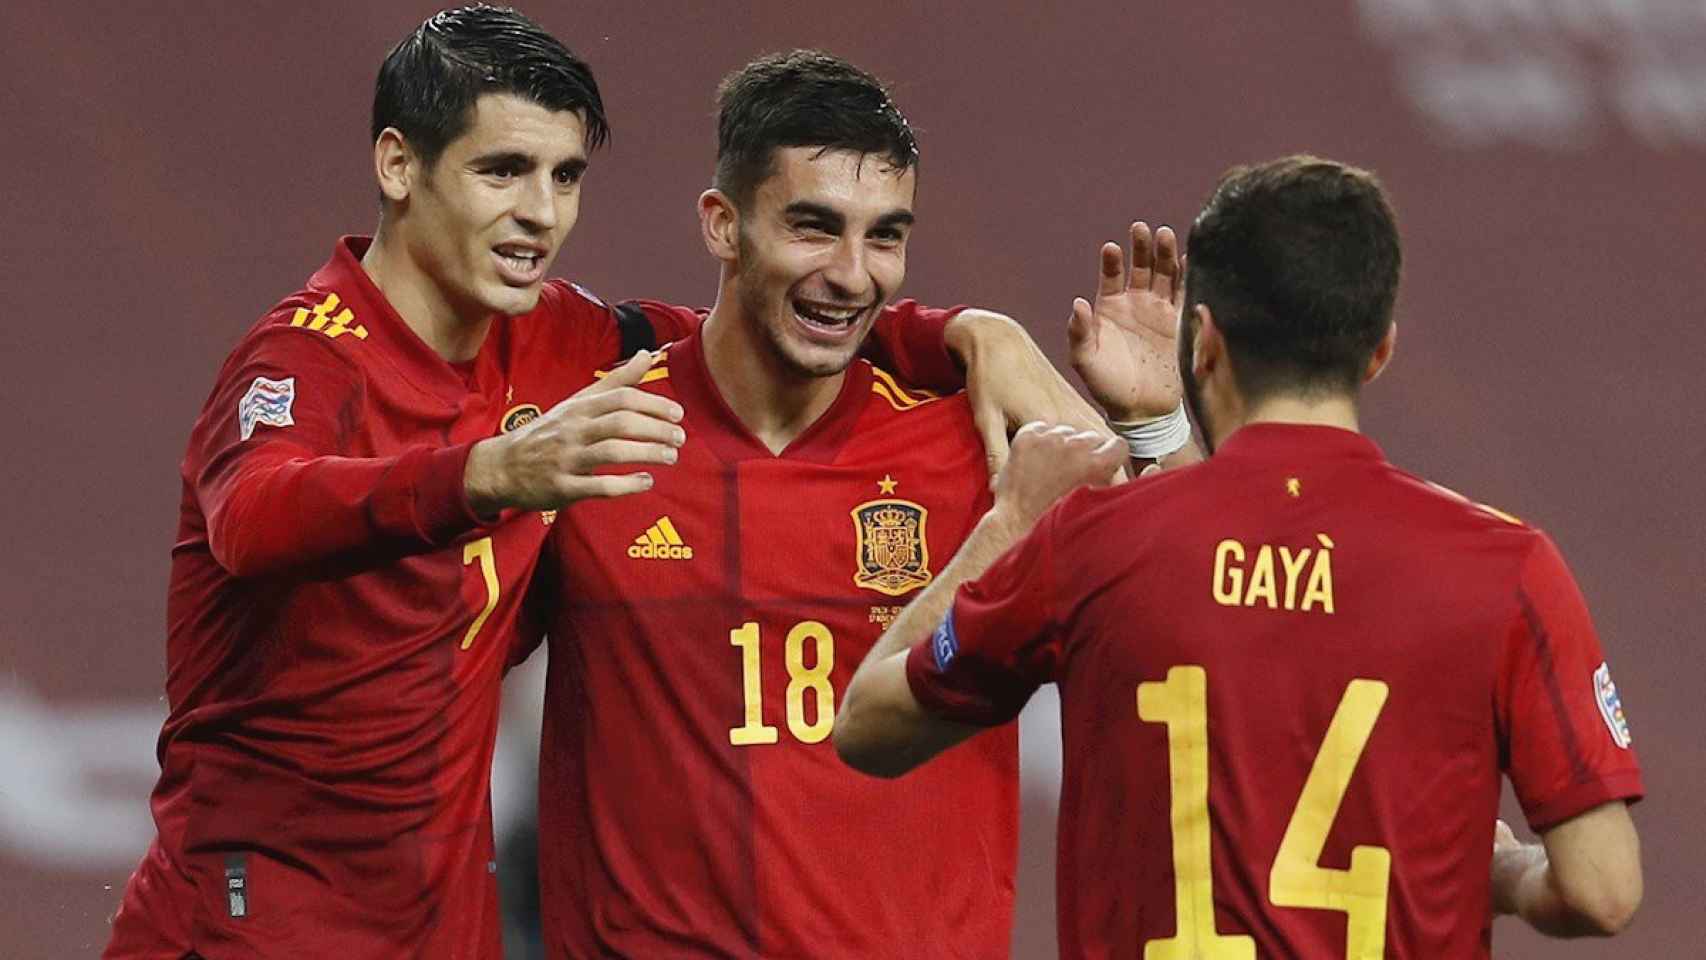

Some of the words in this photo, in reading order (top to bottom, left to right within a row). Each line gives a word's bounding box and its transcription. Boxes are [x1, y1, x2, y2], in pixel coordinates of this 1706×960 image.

[461, 536, 500, 650] 7
[627, 543, 693, 560] adidas
[1212, 533, 1335, 614] GAYÀ
[729, 620, 836, 746] 18
[1137, 665, 1392, 960] 14
